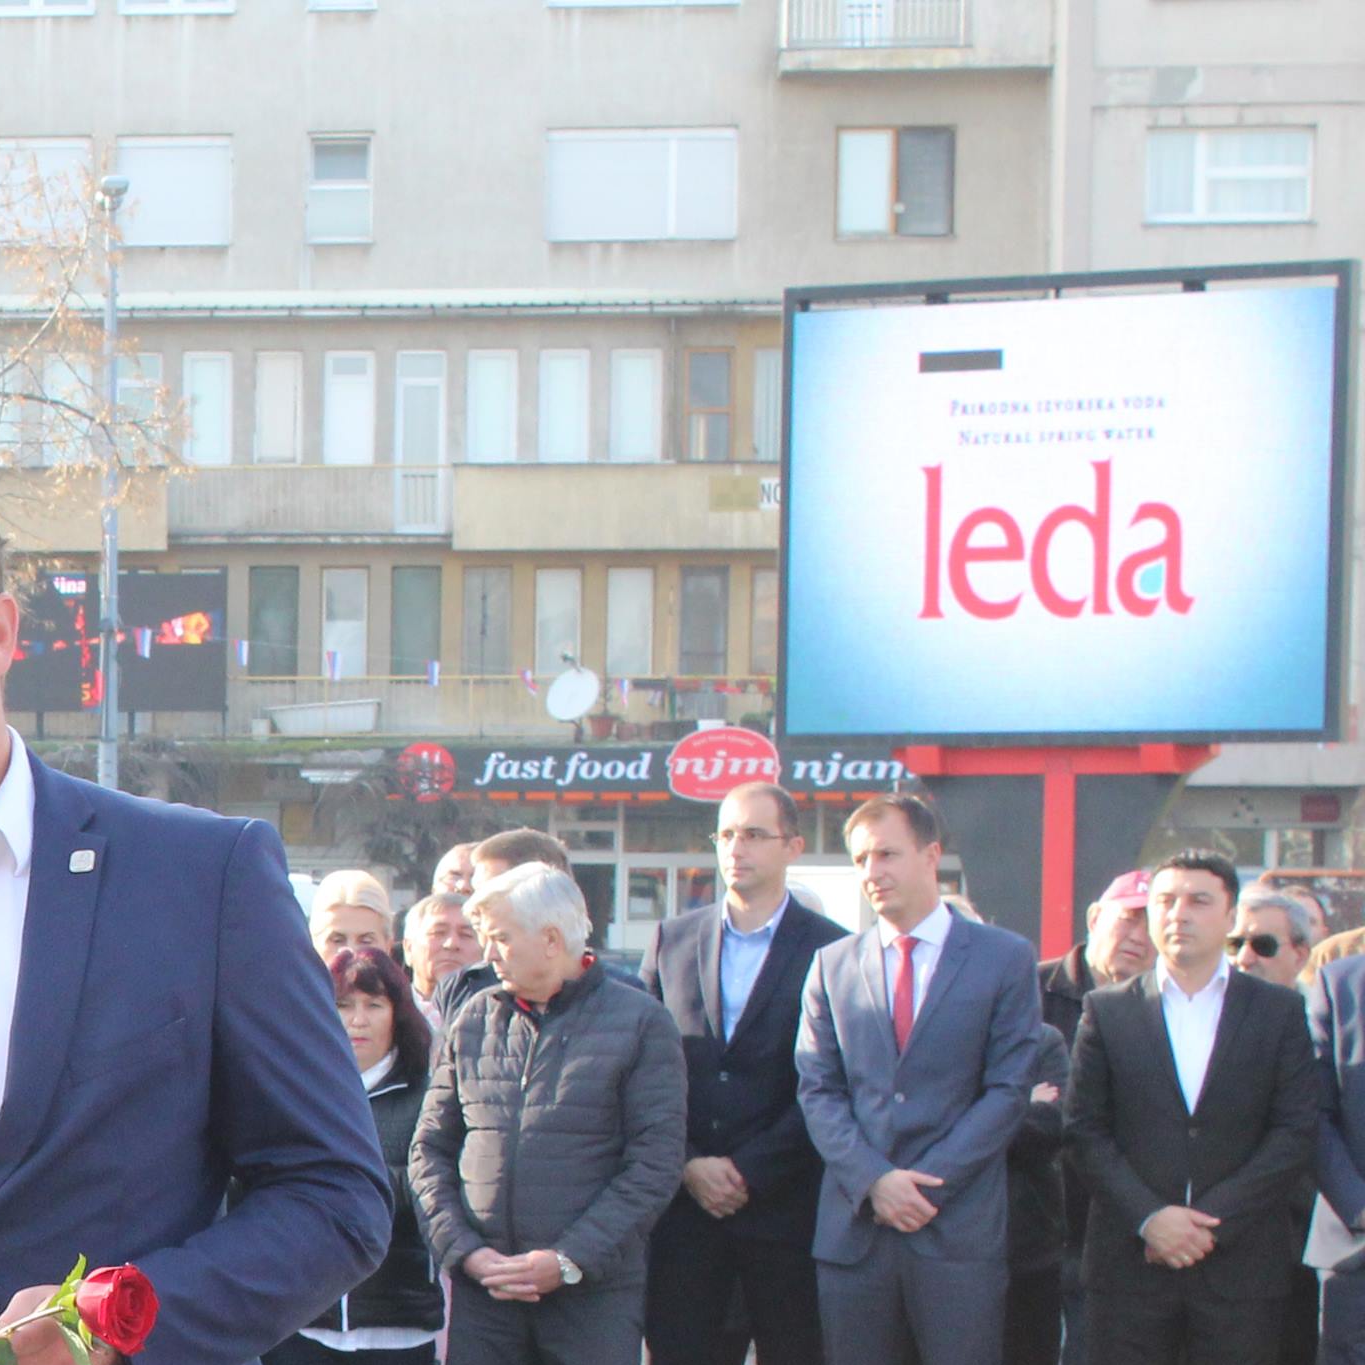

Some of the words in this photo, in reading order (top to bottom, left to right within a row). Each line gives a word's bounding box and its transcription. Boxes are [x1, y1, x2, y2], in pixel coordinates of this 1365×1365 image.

[917, 457, 1196, 620] leda
[474, 751, 557, 786] fast
[556, 751, 652, 786] food
